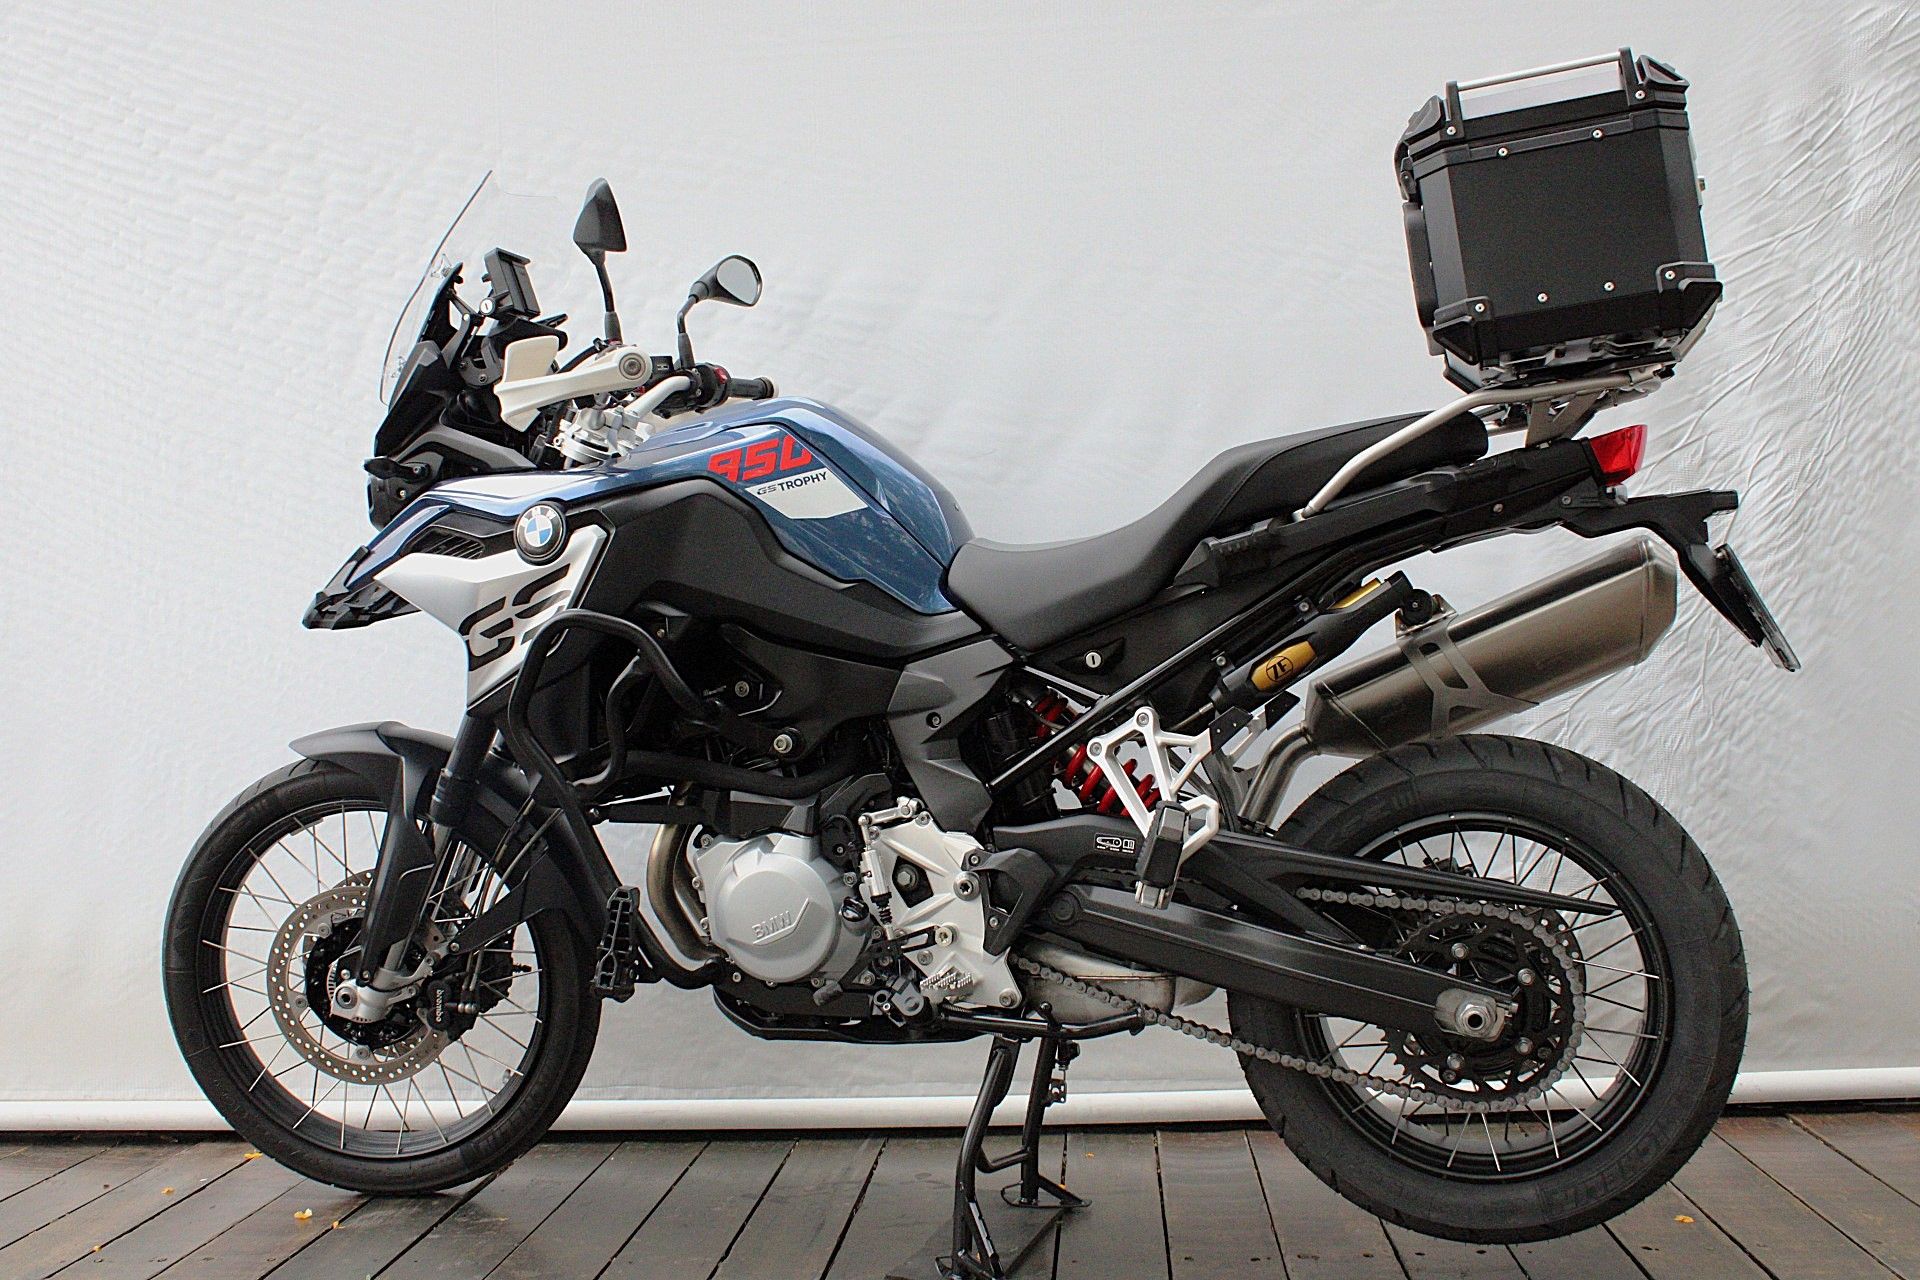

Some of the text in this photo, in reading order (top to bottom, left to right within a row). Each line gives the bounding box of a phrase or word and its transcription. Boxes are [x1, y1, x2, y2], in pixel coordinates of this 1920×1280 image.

[778, 471, 827, 492] TROPHY
[751, 910, 792, 939] BMW
[436, 989, 445, 1022] brembo
